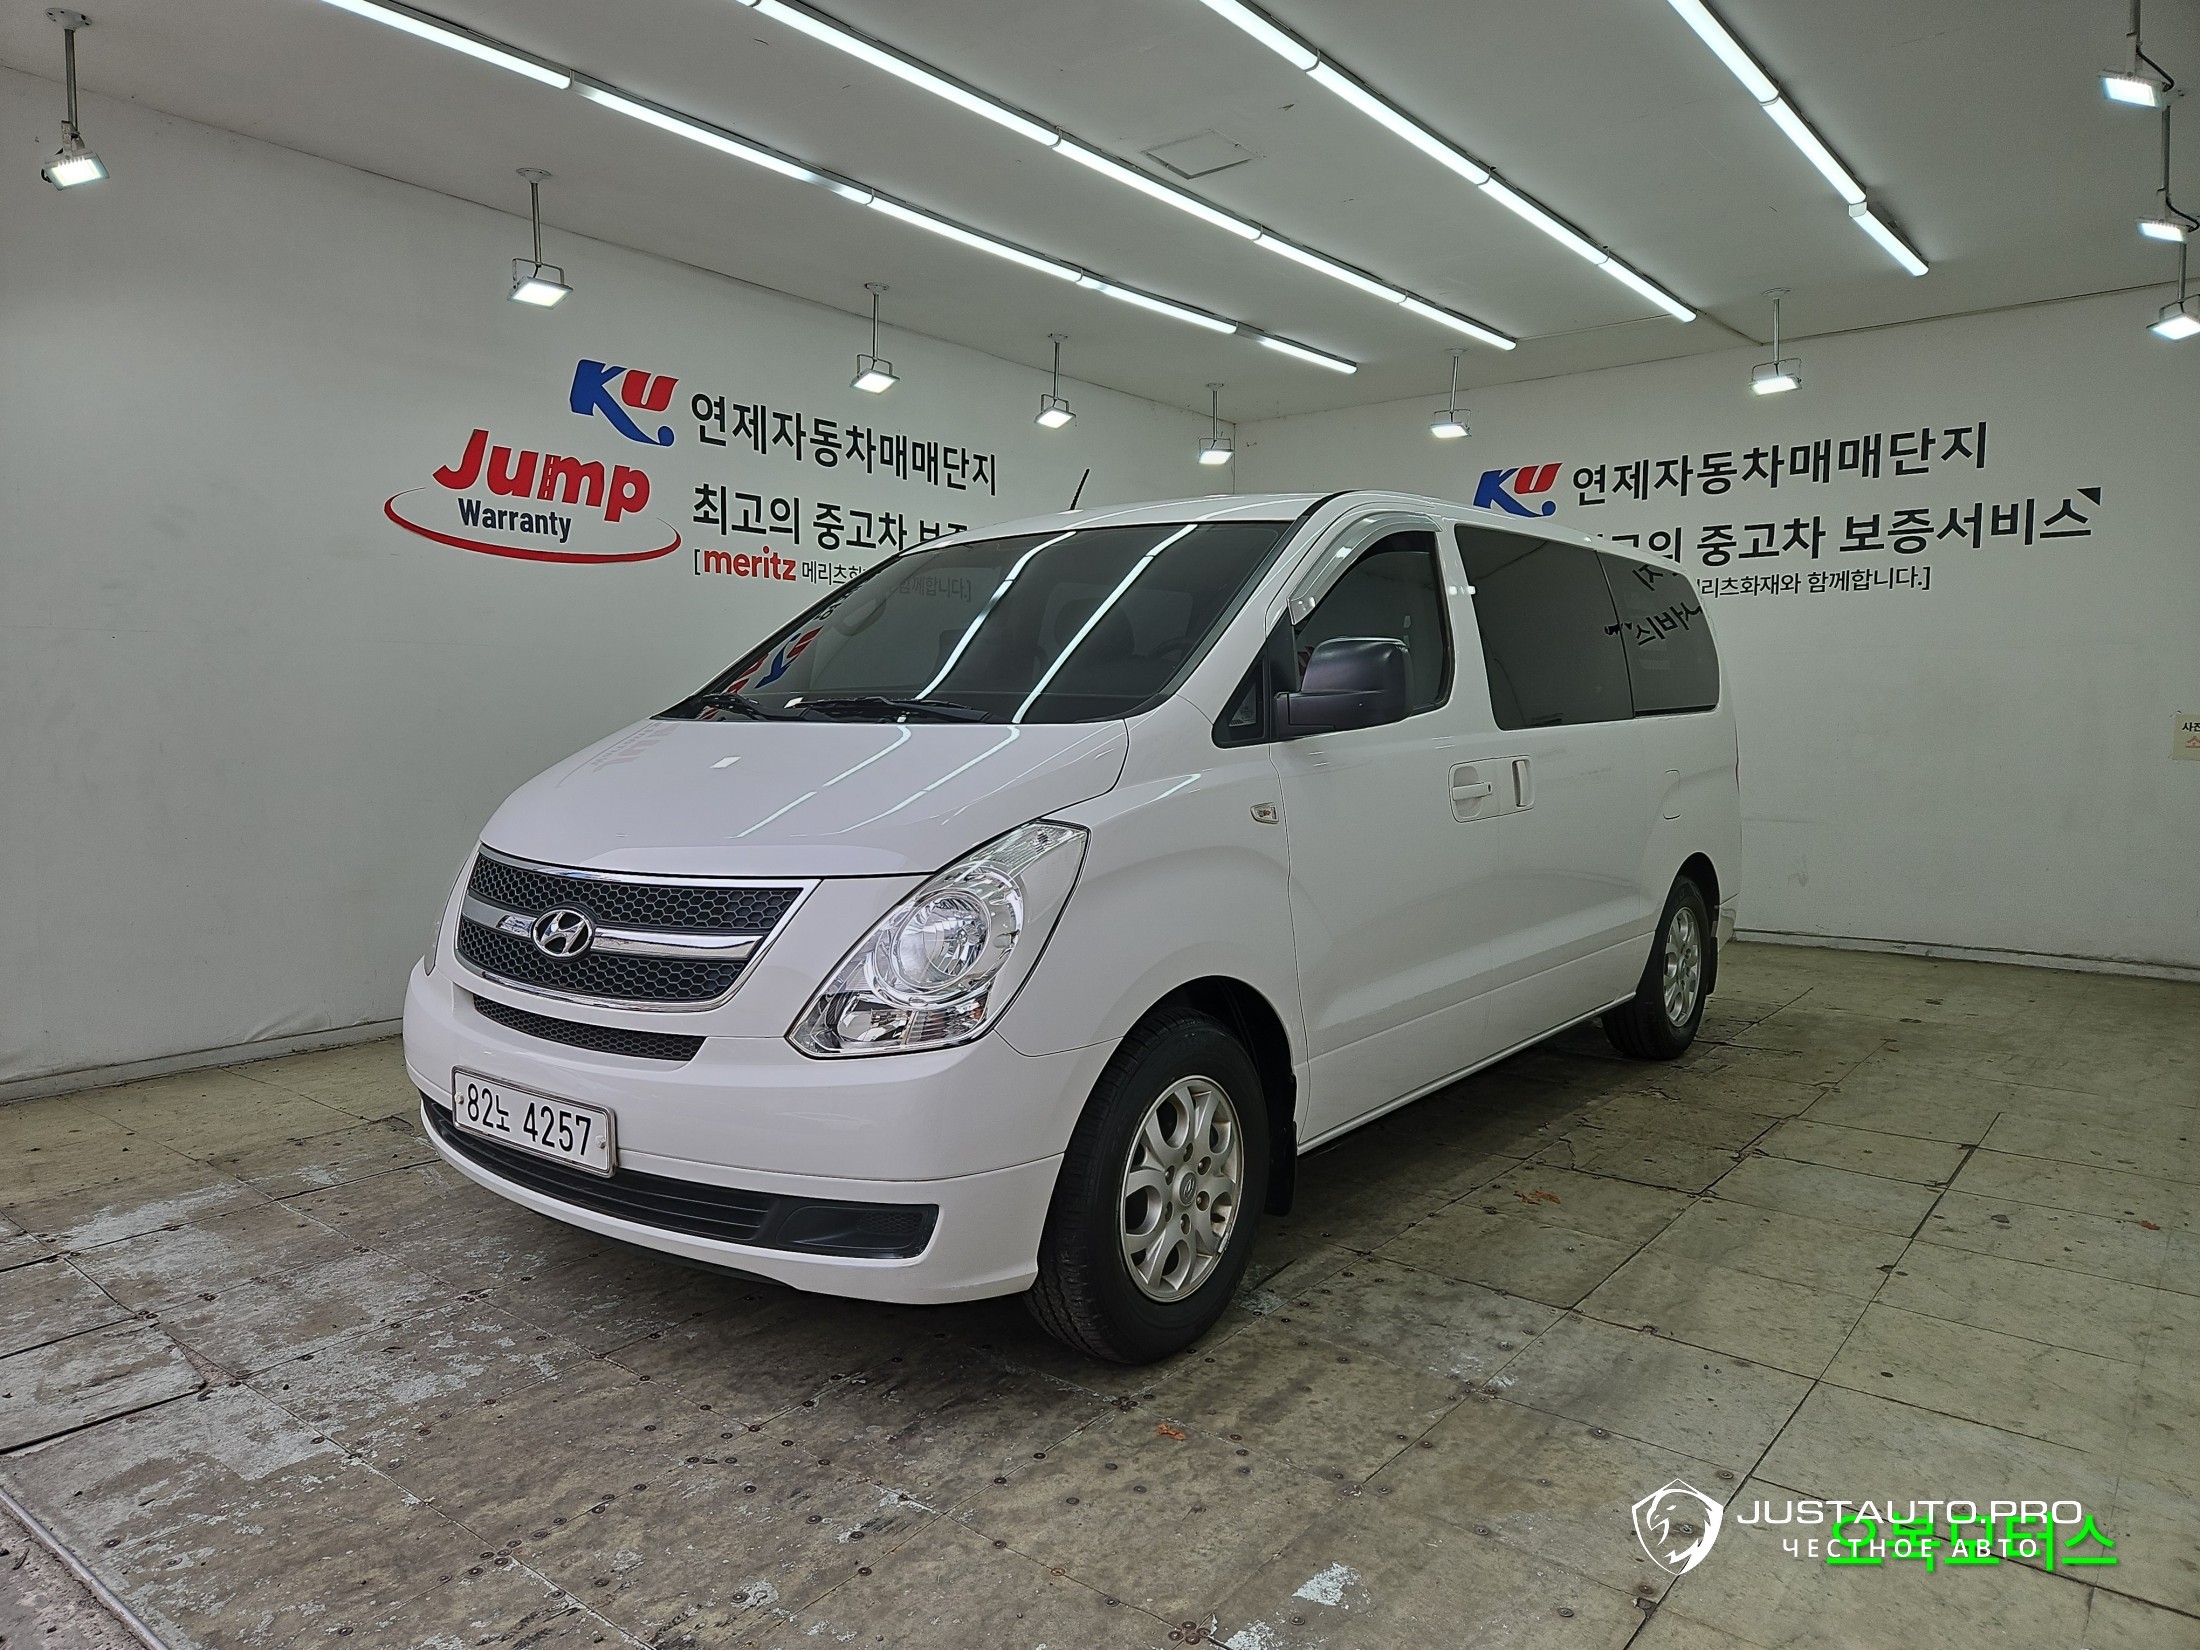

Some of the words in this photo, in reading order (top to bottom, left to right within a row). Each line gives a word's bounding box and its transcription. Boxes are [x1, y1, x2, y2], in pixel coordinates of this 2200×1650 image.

[432, 429, 650, 522] Jump
[691, 393, 996, 496] 연제자동차매매단지
[1573, 421, 1987, 506] 연제자동차매매단지
[457, 497, 571, 543] Warranty
[693, 484, 800, 545] 최고의
[813, 503, 908, 552] 중고차
[1697, 515, 1826, 567] 중고차
[1839, 498, 2092, 554] 보증서비스
[1697, 573, 1801, 599] 리츠화재와
[1807, 566, 1931, 593] 함께합니다.]
[467, 1083, 511, 1132] 82노
[523, 1102, 592, 1156] 4257
